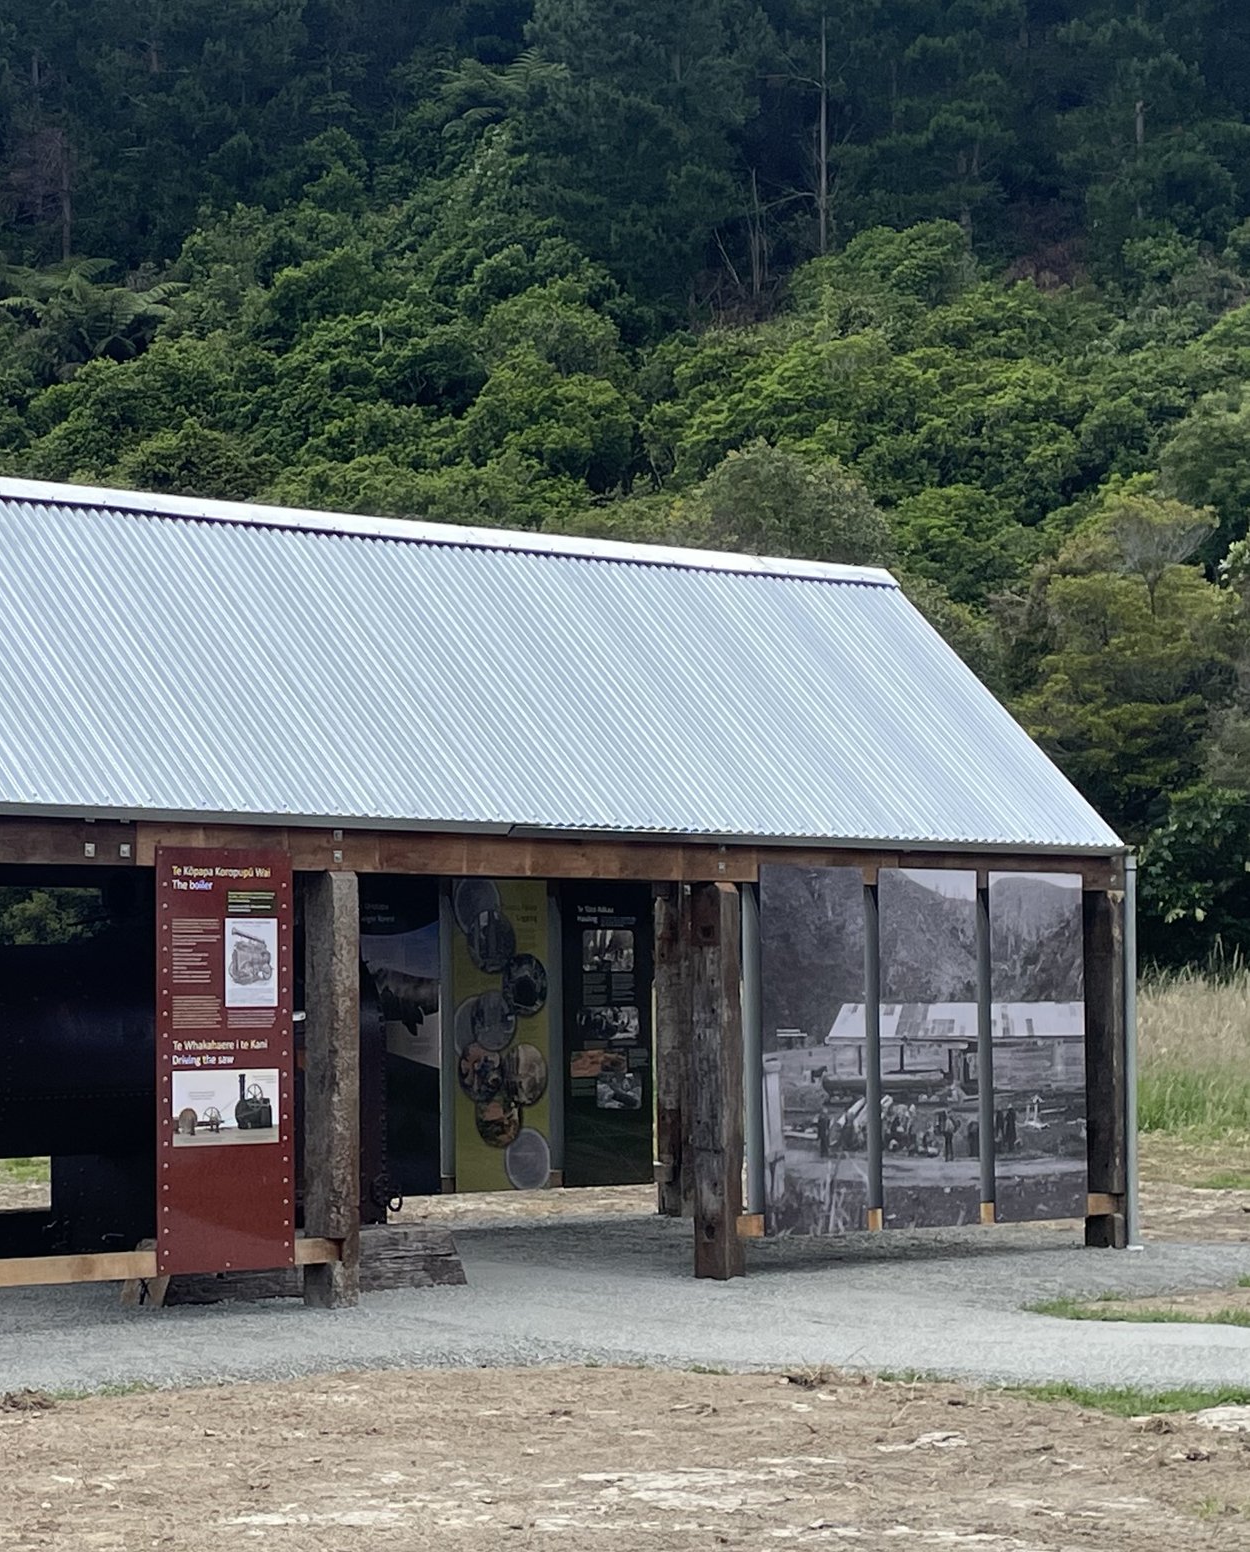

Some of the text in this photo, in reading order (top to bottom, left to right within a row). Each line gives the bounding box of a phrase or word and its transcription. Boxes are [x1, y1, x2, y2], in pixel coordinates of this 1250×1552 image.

[172, 866, 182, 876] Te
[255, 867, 270, 877] Wai
[172, 879, 213, 890] The boiler
[172, 1040, 183, 1051] Te
[184, 1039, 235, 1050] Whakahaere
[250, 1039, 268, 1049] Kani
[172, 1054, 234, 1067] Driving the saw
